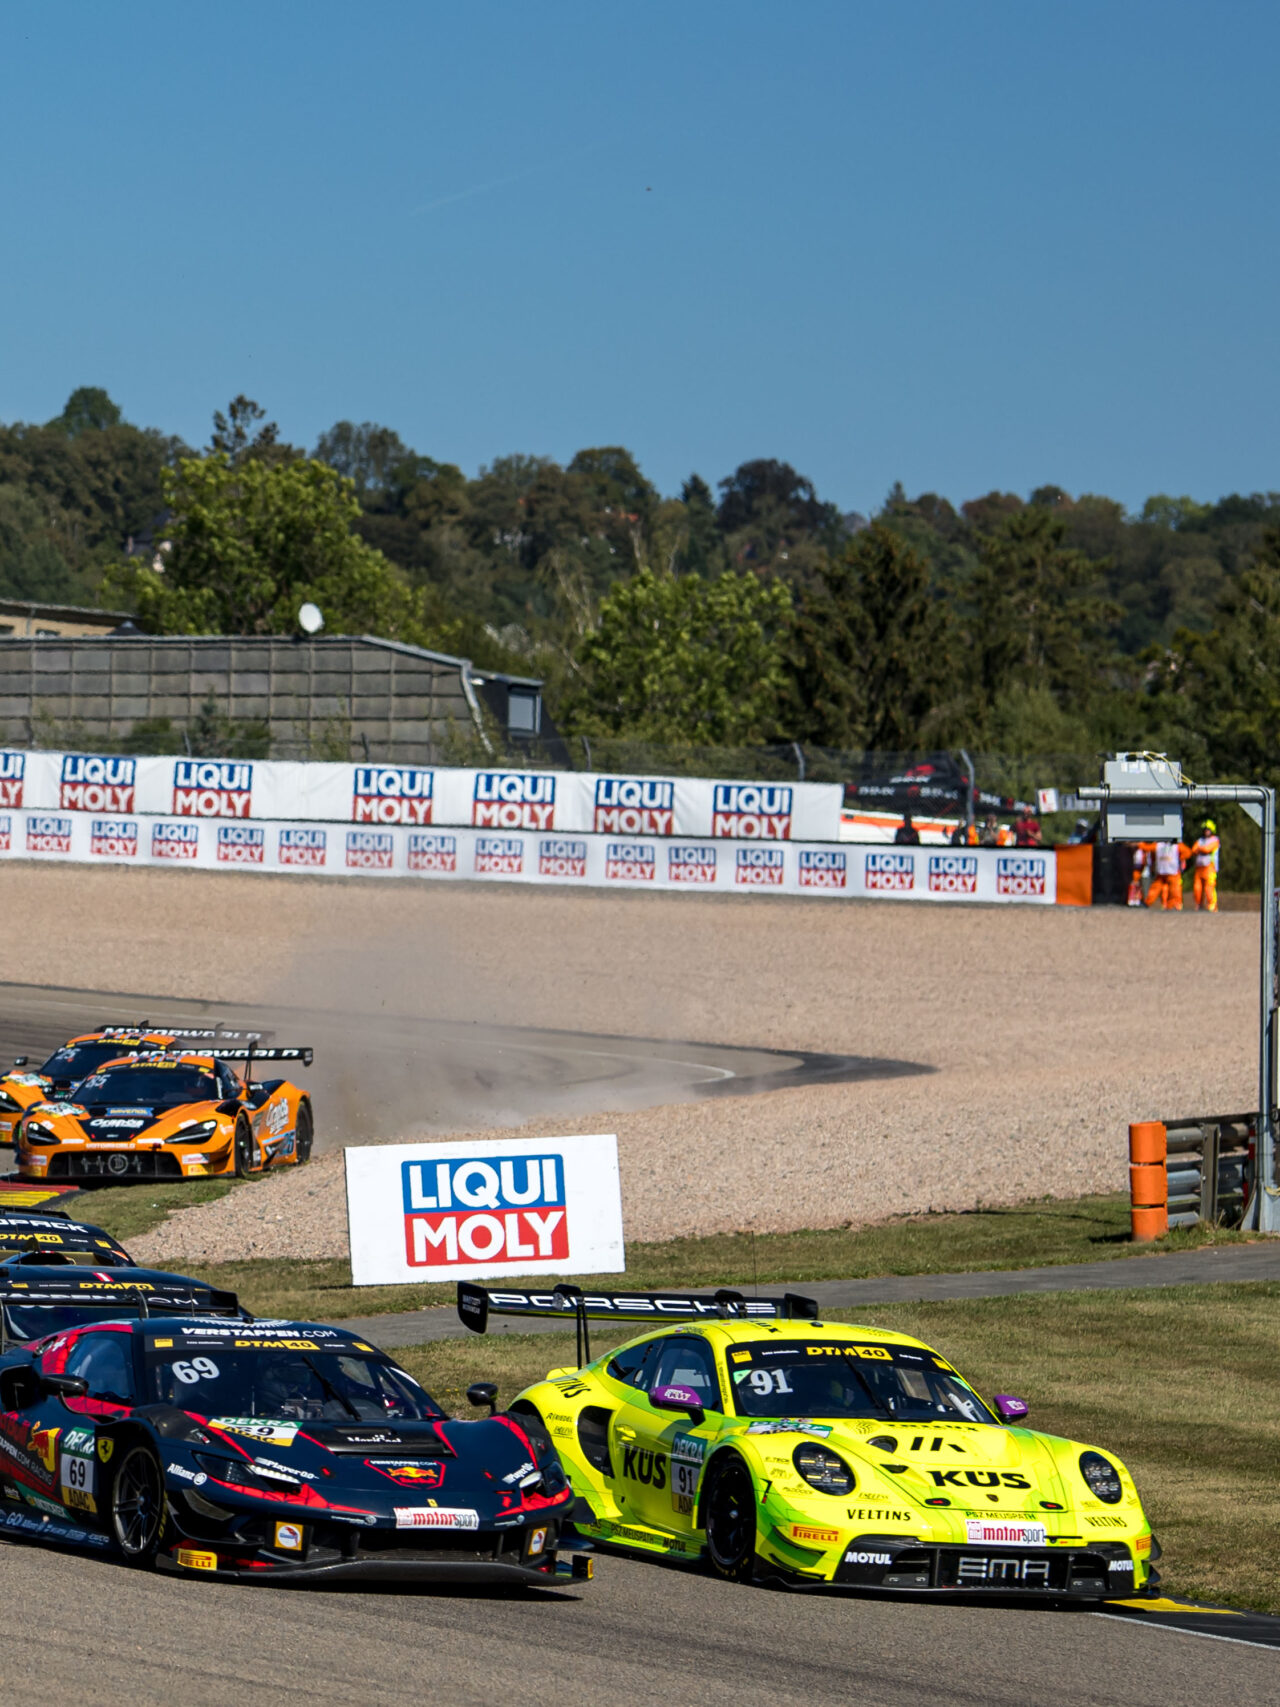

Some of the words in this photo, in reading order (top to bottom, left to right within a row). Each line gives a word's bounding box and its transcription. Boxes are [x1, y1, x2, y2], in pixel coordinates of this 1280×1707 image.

[63, 757, 135, 785] LIQUI
[177, 763, 252, 790] LIQUI
[357, 770, 433, 797] LIQUI
[477, 775, 555, 803] LIQUI
[62, 785, 134, 812] MOLY
[599, 780, 672, 808] LIQUI
[717, 787, 791, 815] LIQUI
[176, 790, 250, 816] MOLY
[356, 798, 432, 824] MOLY
[477, 803, 554, 829] MOLY
[597, 808, 671, 836] MOLY
[28, 819, 71, 835] LIQUI
[93, 822, 137, 838] LIQUI
[154, 825, 198, 841] LIQUI
[716, 815, 790, 840] MOLY
[29, 835, 70, 851] MOLY
[219, 828, 263, 844] LIQUI
[280, 831, 325, 847] LIQUI
[348, 834, 392, 850] LIQUI
[410, 836, 455, 852] LIQUI
[93, 839, 136, 855] MOLY
[154, 840, 196, 858] MOLY
[219, 845, 263, 862] MOLY
[281, 847, 325, 864] MOLY
[477, 840, 522, 855] LIQUI
[540, 842, 585, 858] LIQUI
[607, 845, 654, 862] LIQUI
[348, 851, 391, 867] MOLY
[410, 853, 455, 870] MOLY
[478, 856, 521, 872] MOLY
[669, 848, 715, 864] LIQUI
[738, 850, 783, 866] LIQUI
[800, 853, 845, 869] LIQUI
[866, 855, 913, 872] LIQUI
[541, 858, 585, 876] MOLY
[608, 862, 653, 879] MOLY
[671, 865, 715, 881] MOLY
[929, 858, 977, 874] LIQUI
[996, 860, 1045, 876] LIQUI
[738, 867, 782, 884] MOLY
[801, 869, 845, 887] MOLY
[867, 872, 913, 889] MOLY
[931, 875, 976, 892] MOLY
[999, 877, 1044, 894] MOLY
[409, 1159, 558, 1210] LIQUI
[39, 1234, 59, 1243] 40
[413, 1211, 564, 1263] MOLY
[488, 1292, 776, 1314] PORSCHE
[181, 1328, 338, 1338] VERSTAPPEN.COM
[235, 1340, 285, 1349] DTM
[289, 1341, 313, 1349] 40
[806, 1347, 857, 1356] DTM
[862, 1349, 885, 1358] 40
[172, 1357, 220, 1384] 69
[750, 1369, 794, 1396] 91
[219, 1417, 298, 1428] DEKRA
[673, 1437, 704, 1462] DEKRA
[69, 1458, 86, 1488] 69
[167, 1463, 196, 1481] Allianz
[622, 1447, 667, 1490] KÜS
[678, 1467, 695, 1496] 91
[926, 1470, 1032, 1489] KÜS
[413, 1511, 479, 1529] motorsport
[847, 1509, 912, 1521] VELTINS
[966, 1511, 984, 1519] PSZ
[986, 1512, 1036, 1521] MEUSPATH
[1084, 1516, 1128, 1528] VELTINS
[793, 1526, 839, 1542] PIRELLI
[983, 1526, 1046, 1544] motorsport
[844, 1551, 893, 1566] MOTUL
[958, 1557, 1050, 1580] EMA
